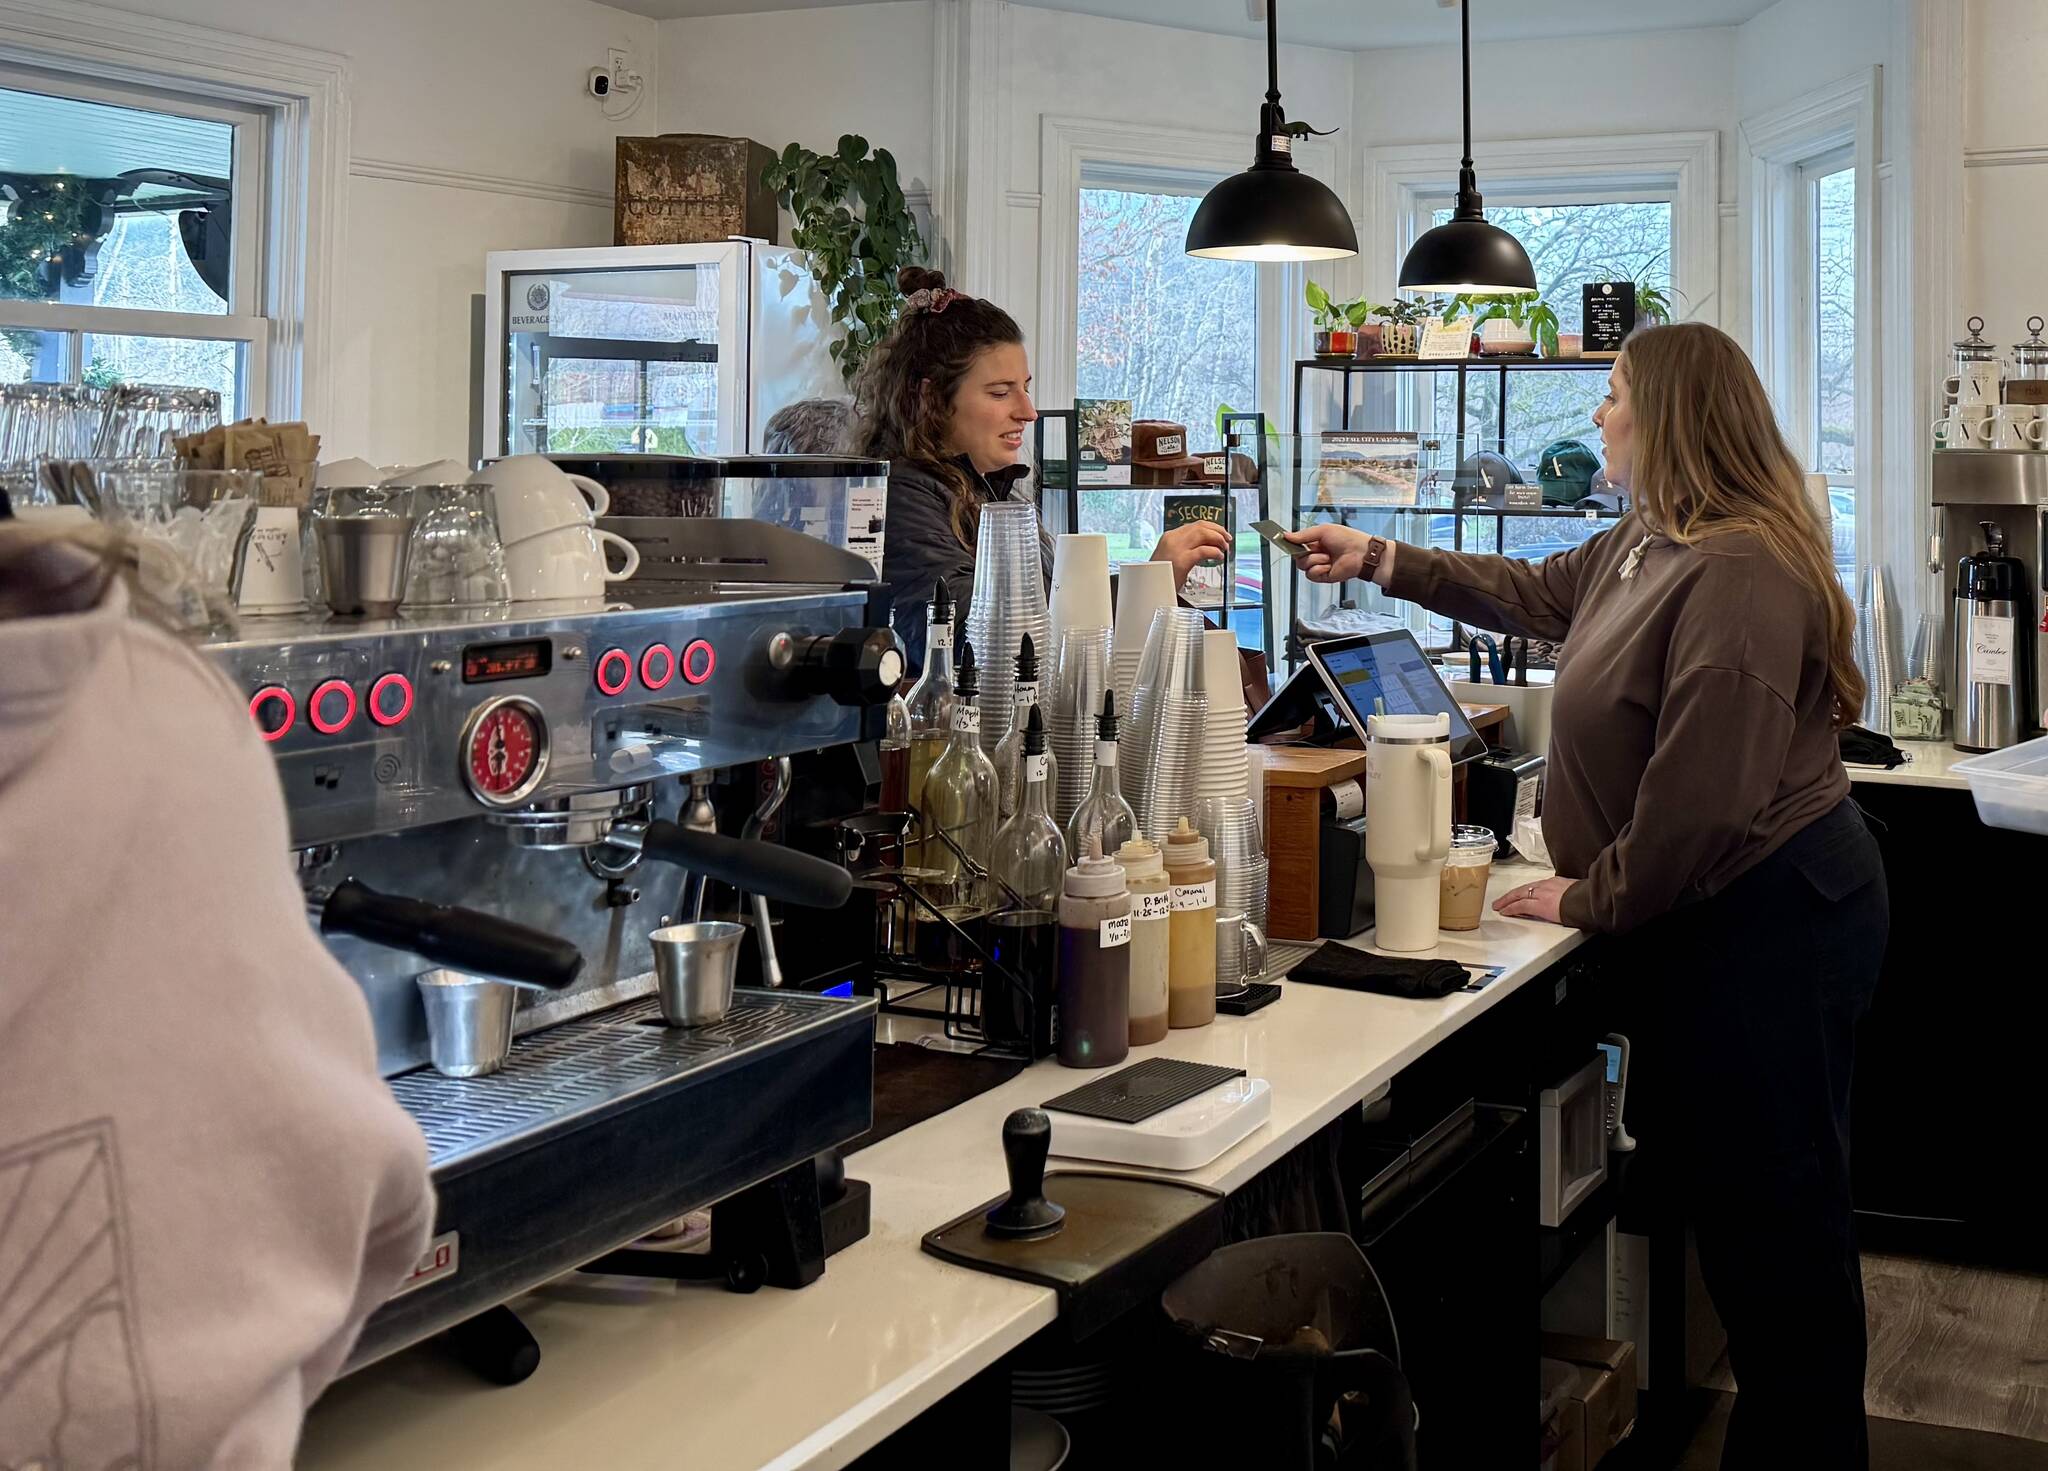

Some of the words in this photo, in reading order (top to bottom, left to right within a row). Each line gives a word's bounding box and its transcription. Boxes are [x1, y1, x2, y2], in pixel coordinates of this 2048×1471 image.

[628, 196, 739, 217] COFFE
[1206, 457, 1226, 467] NELS
[1178, 505, 1222, 521] SECRET
